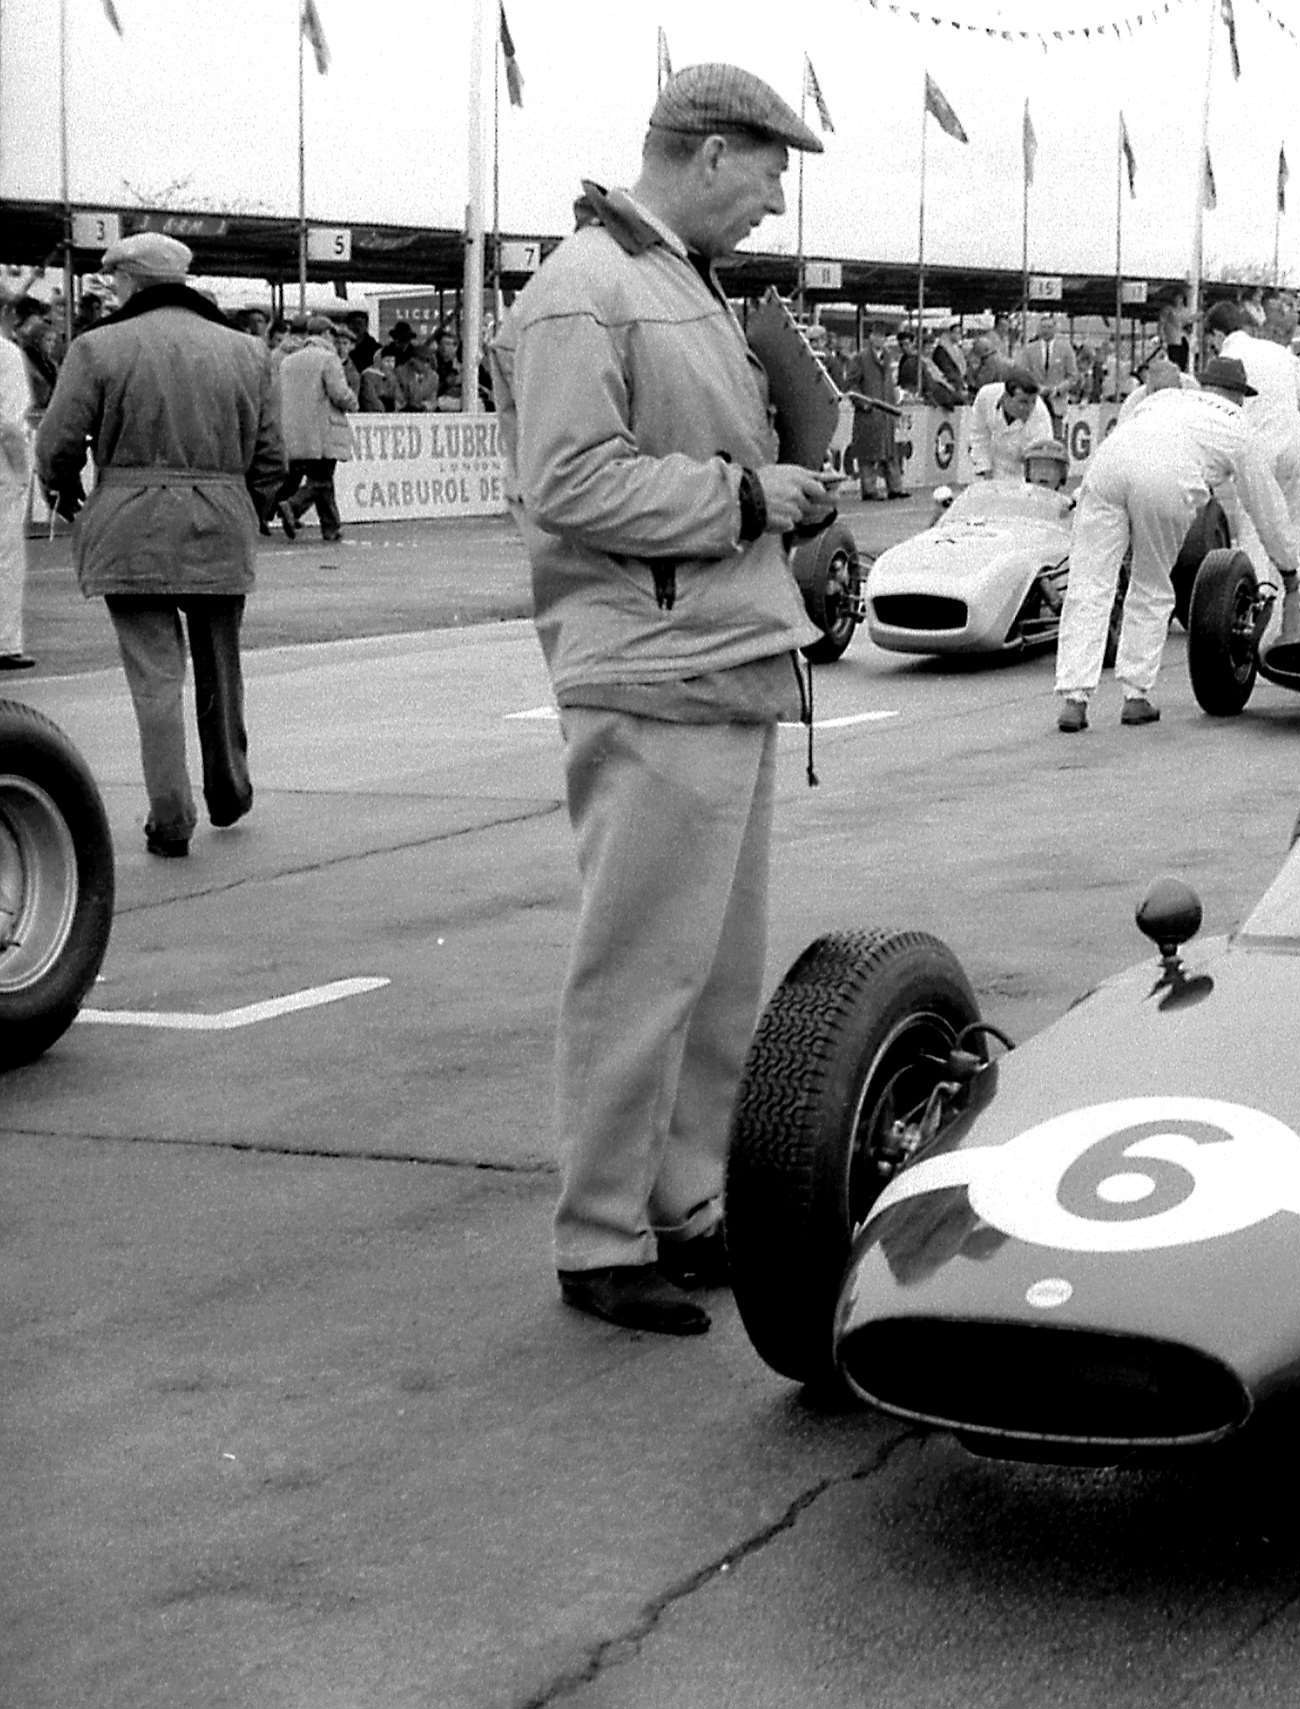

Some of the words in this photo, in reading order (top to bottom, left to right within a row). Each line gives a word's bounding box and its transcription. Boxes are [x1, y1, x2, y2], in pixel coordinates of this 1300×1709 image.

[97, 219, 105, 241] 3
[334, 235, 345, 255] 5
[524, 247, 534, 266] 7
[430, 423, 502, 459] LUBRI
[354, 478, 470, 508] CARBUROL
[1056, 1118, 1235, 1223] 6
